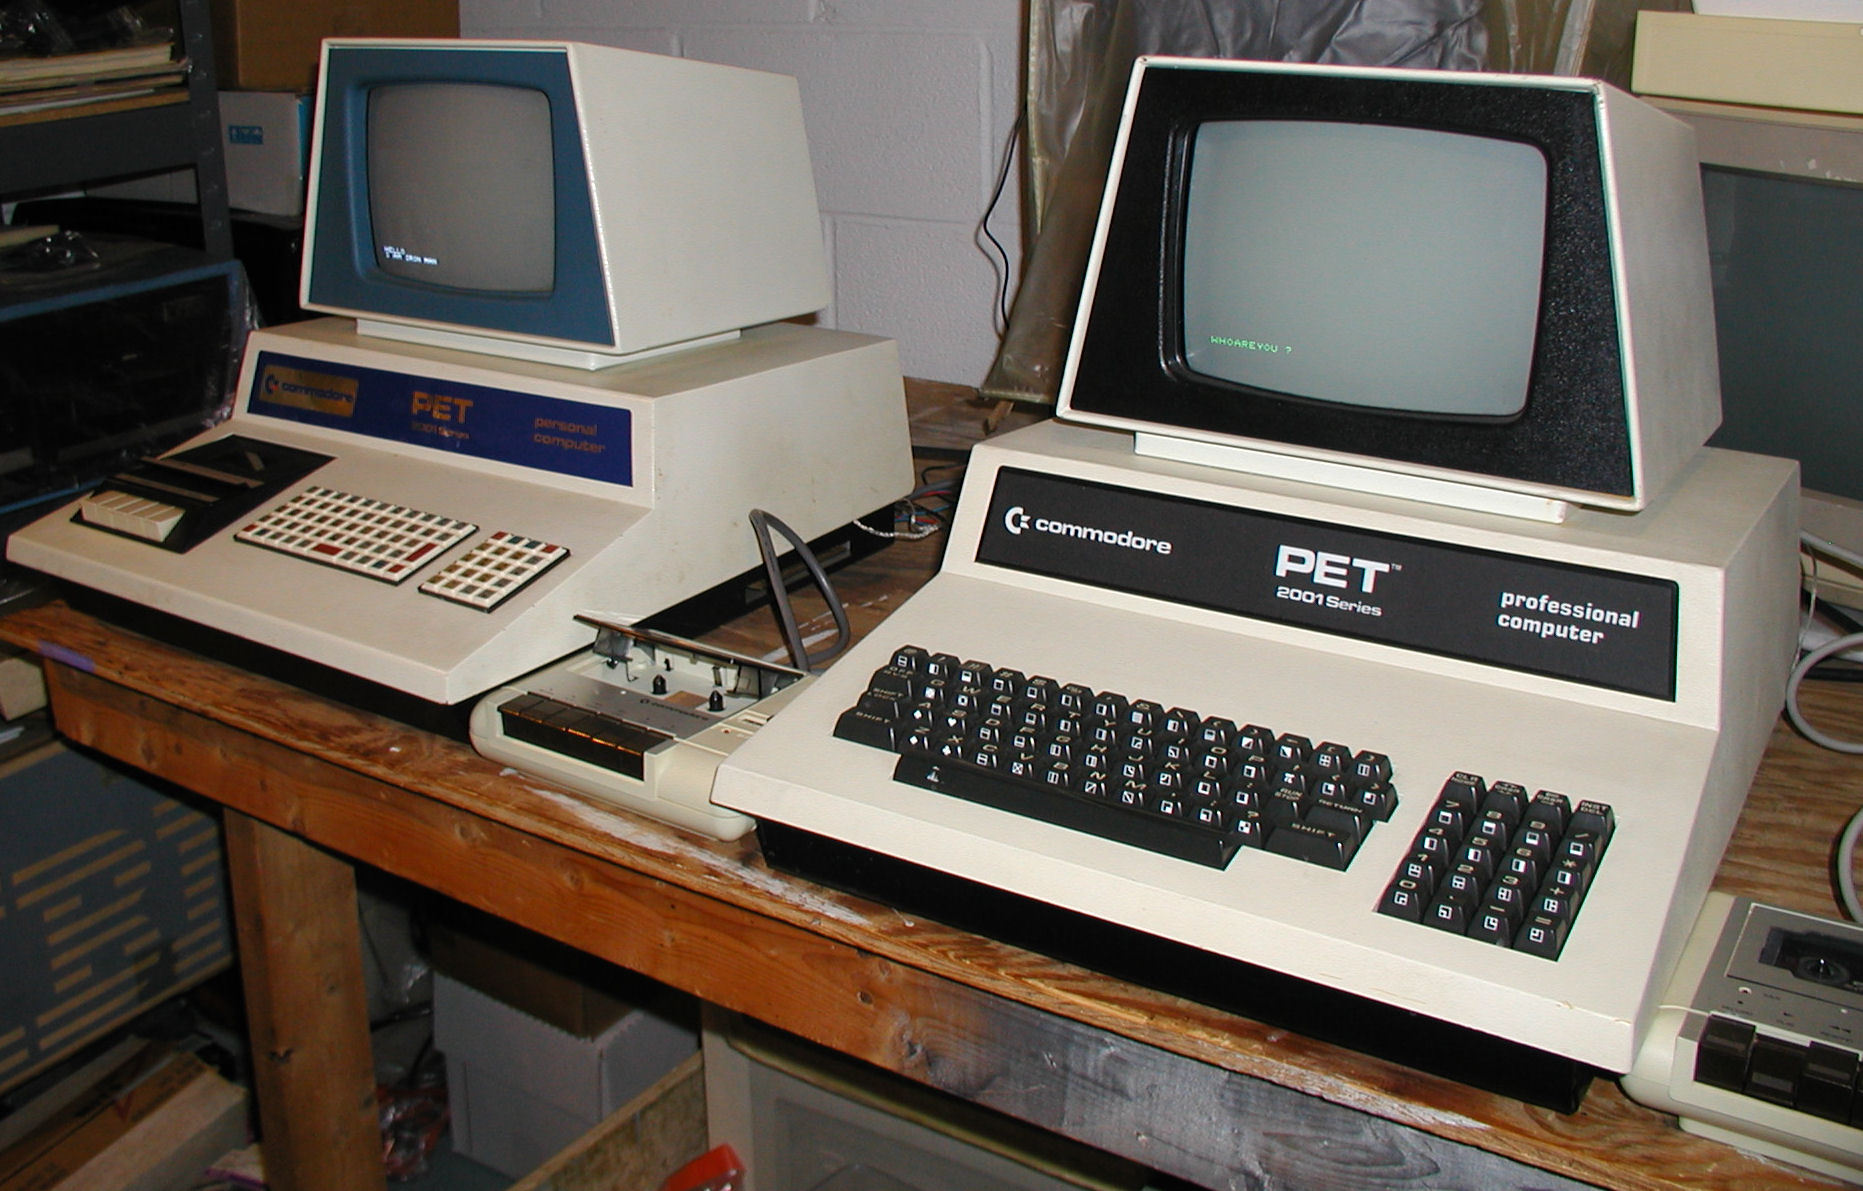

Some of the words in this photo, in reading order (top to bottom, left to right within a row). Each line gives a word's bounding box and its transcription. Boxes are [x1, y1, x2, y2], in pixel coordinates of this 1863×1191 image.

[281, 382, 355, 402] commodore
[411, 391, 474, 424] PET
[532, 432, 606, 453] computer
[534, 416, 598, 437] personal
[1035, 518, 1172, 555] commodore
[1275, 544, 1391, 594] PET
[1276, 585, 1325, 606] 2001
[1325, 594, 1382, 617] Series
[1500, 591, 1640, 629] professional
[1497, 613, 1604, 645] computer
